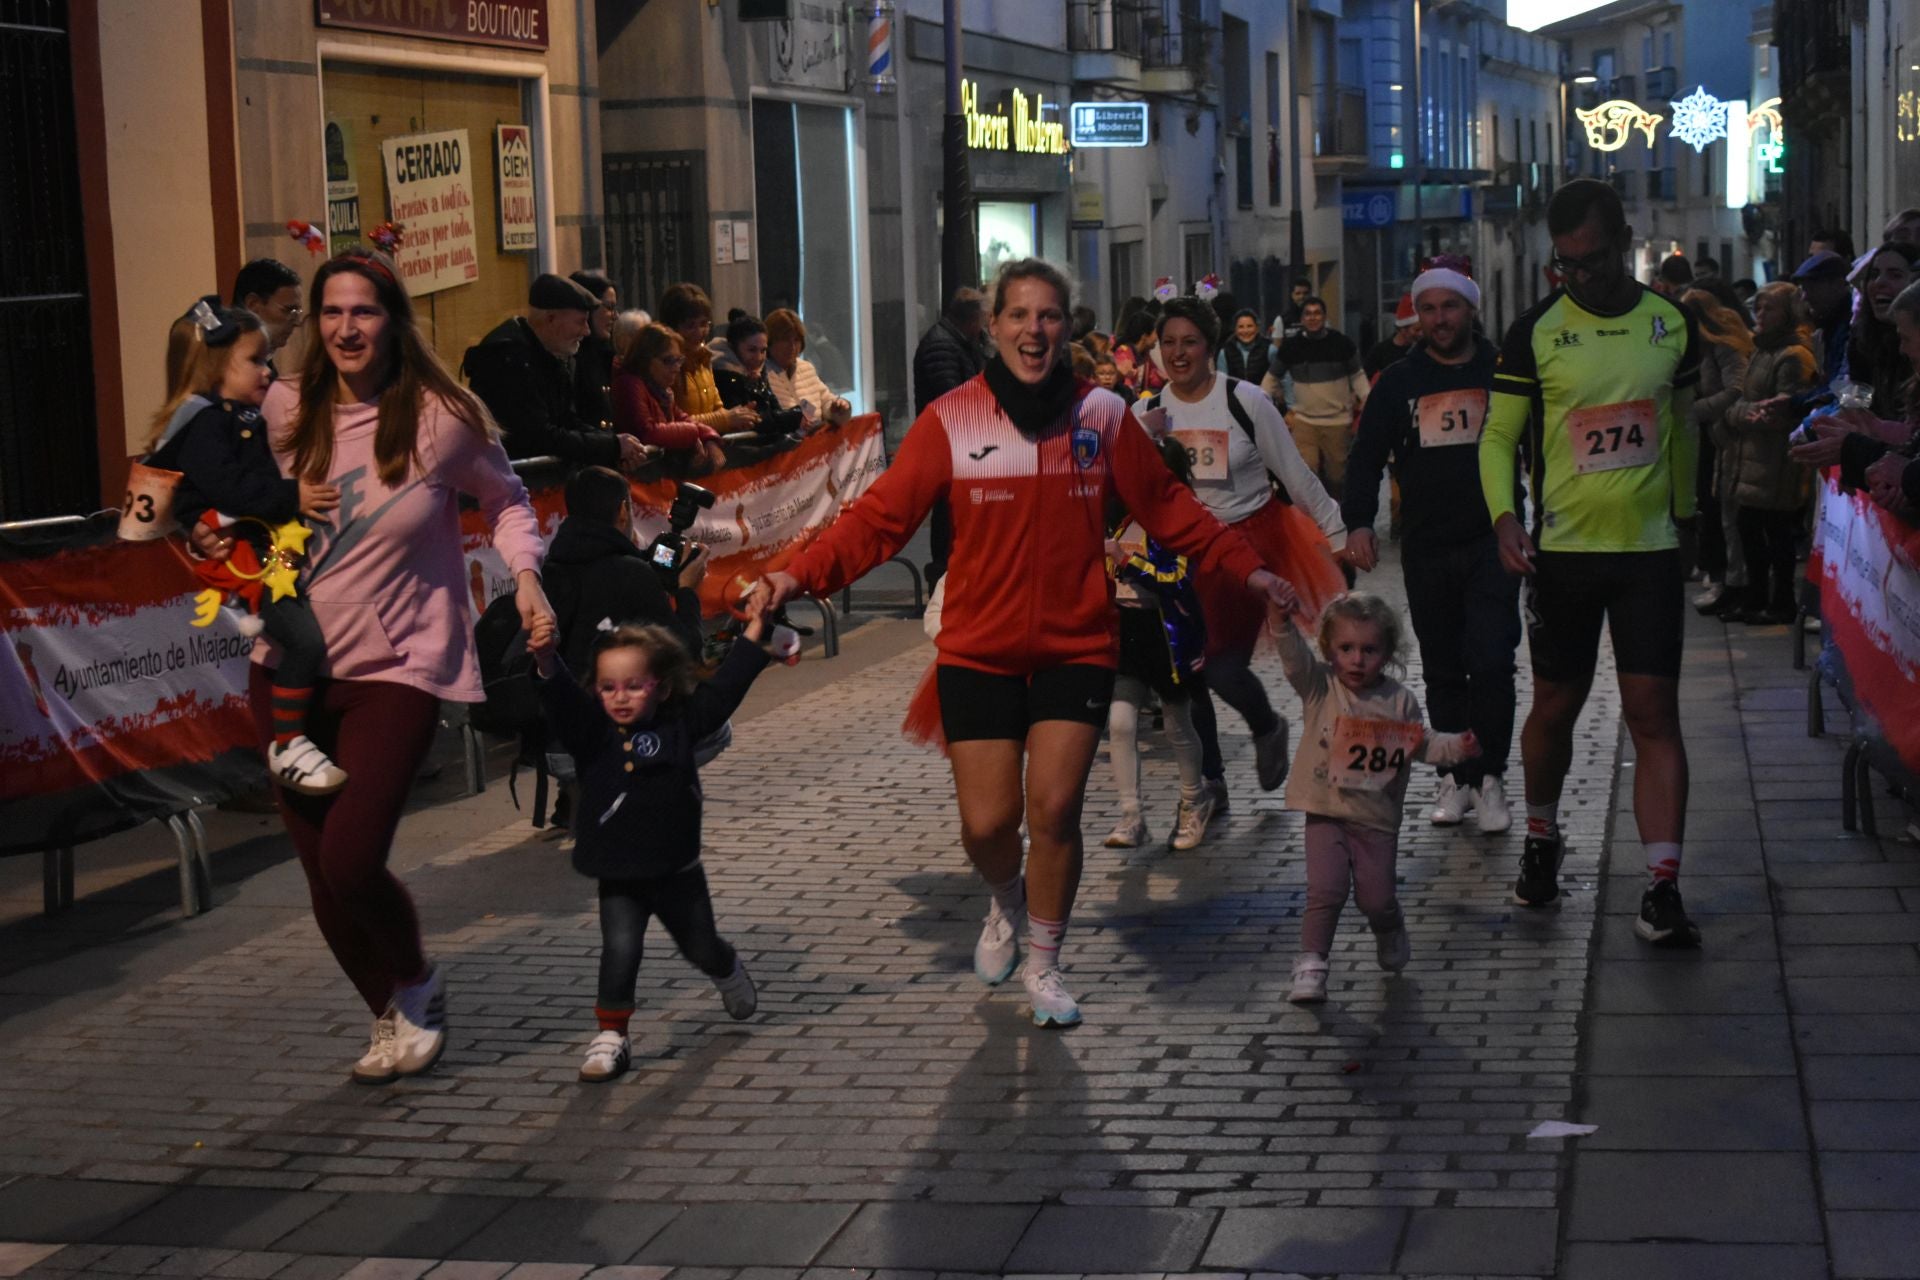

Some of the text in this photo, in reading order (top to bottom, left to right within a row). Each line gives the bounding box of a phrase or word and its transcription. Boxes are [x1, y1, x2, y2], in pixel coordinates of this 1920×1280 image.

[468, 1, 539, 40] BOUTIQUE
[1013, 87, 1063, 154] Moderna
[396, 139, 461, 183] CERRADO
[503, 156, 529, 177] CIEM
[432, 196, 438, 213] a
[504, 196, 535, 224] ALQUILA
[433, 225, 448, 251] por
[434, 253, 448, 279] por
[1441, 409, 1468, 431] 51
[1585, 424, 1644, 455] 274
[54, 648, 162, 699] Ayuntamiento
[167, 642, 185, 671] de
[1347, 745, 1404, 772] 284
